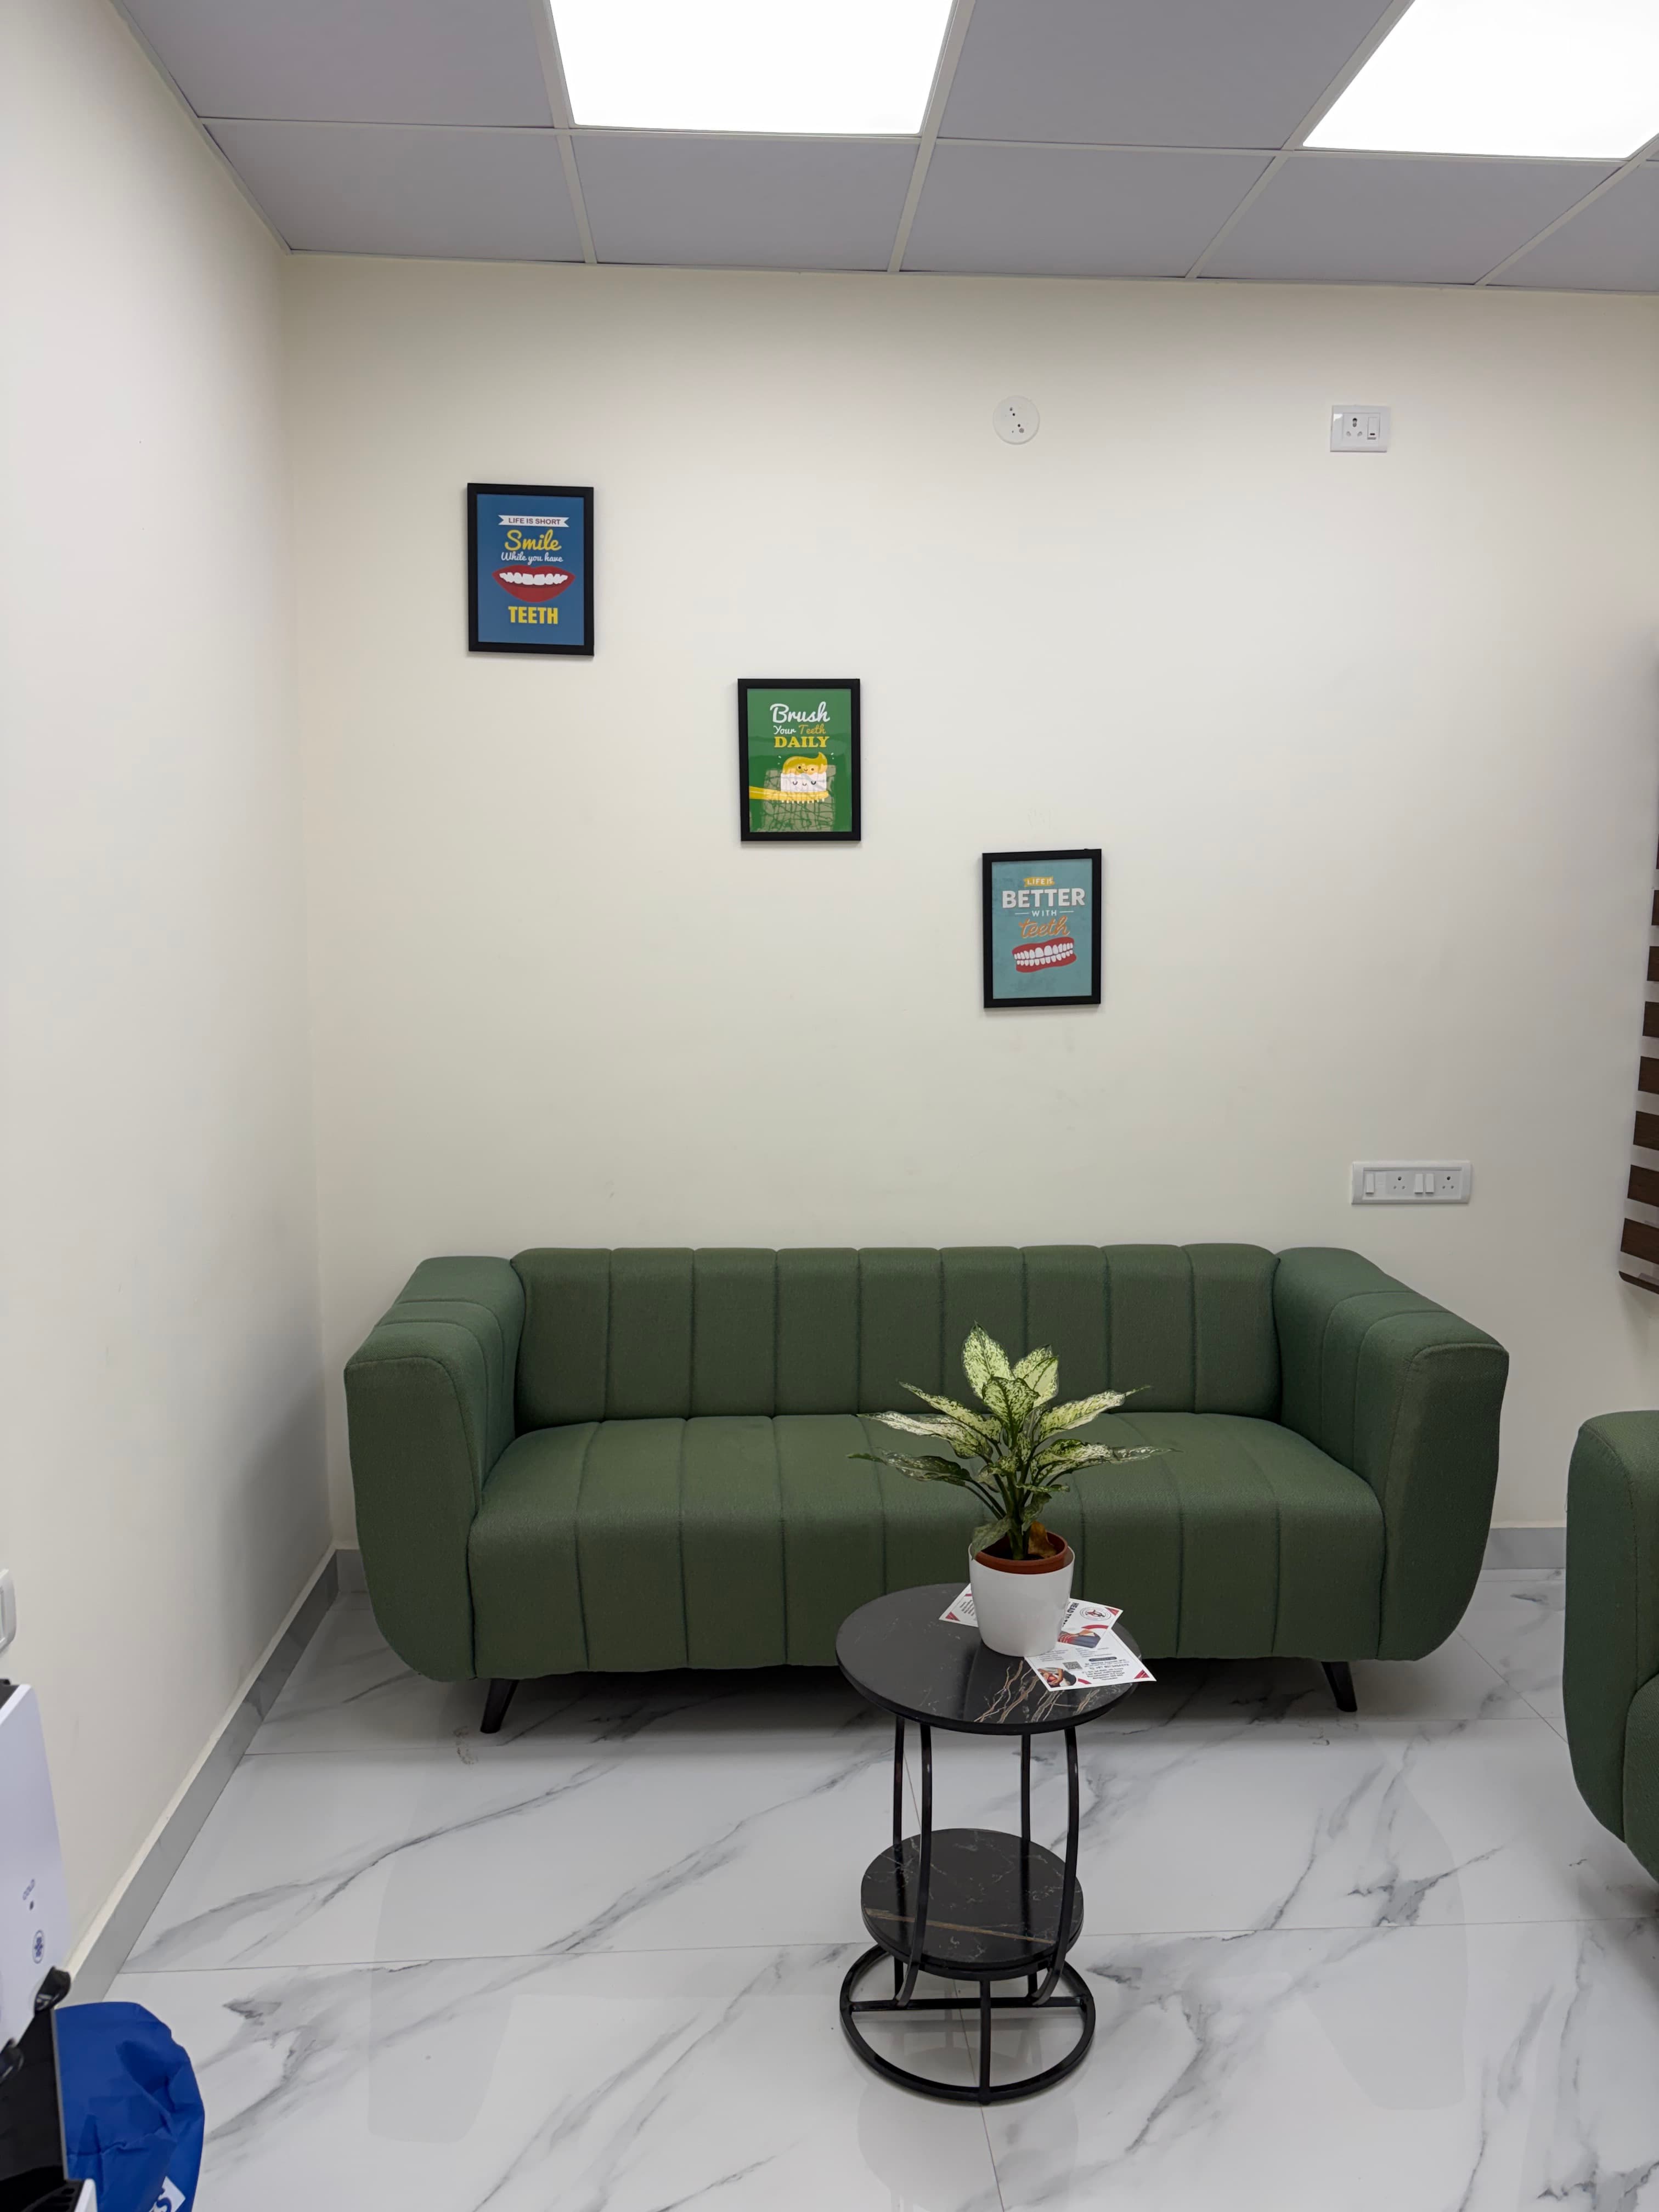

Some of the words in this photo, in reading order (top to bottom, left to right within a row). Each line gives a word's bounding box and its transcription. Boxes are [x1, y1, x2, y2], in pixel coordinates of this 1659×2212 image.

[505, 529, 562, 551] Smile
[501, 551, 527, 561] While
[528, 555, 543, 565] you
[544, 552, 563, 562] have
[508, 606, 558, 624] TEETH
[770, 701, 831, 724] Brush
[773, 725, 797, 735] Your
[798, 724, 826, 735] Teeth
[774, 736, 830, 748] DAILY
[1002, 888, 1085, 909] BETTER
[1019, 915, 1070, 939] teeth
